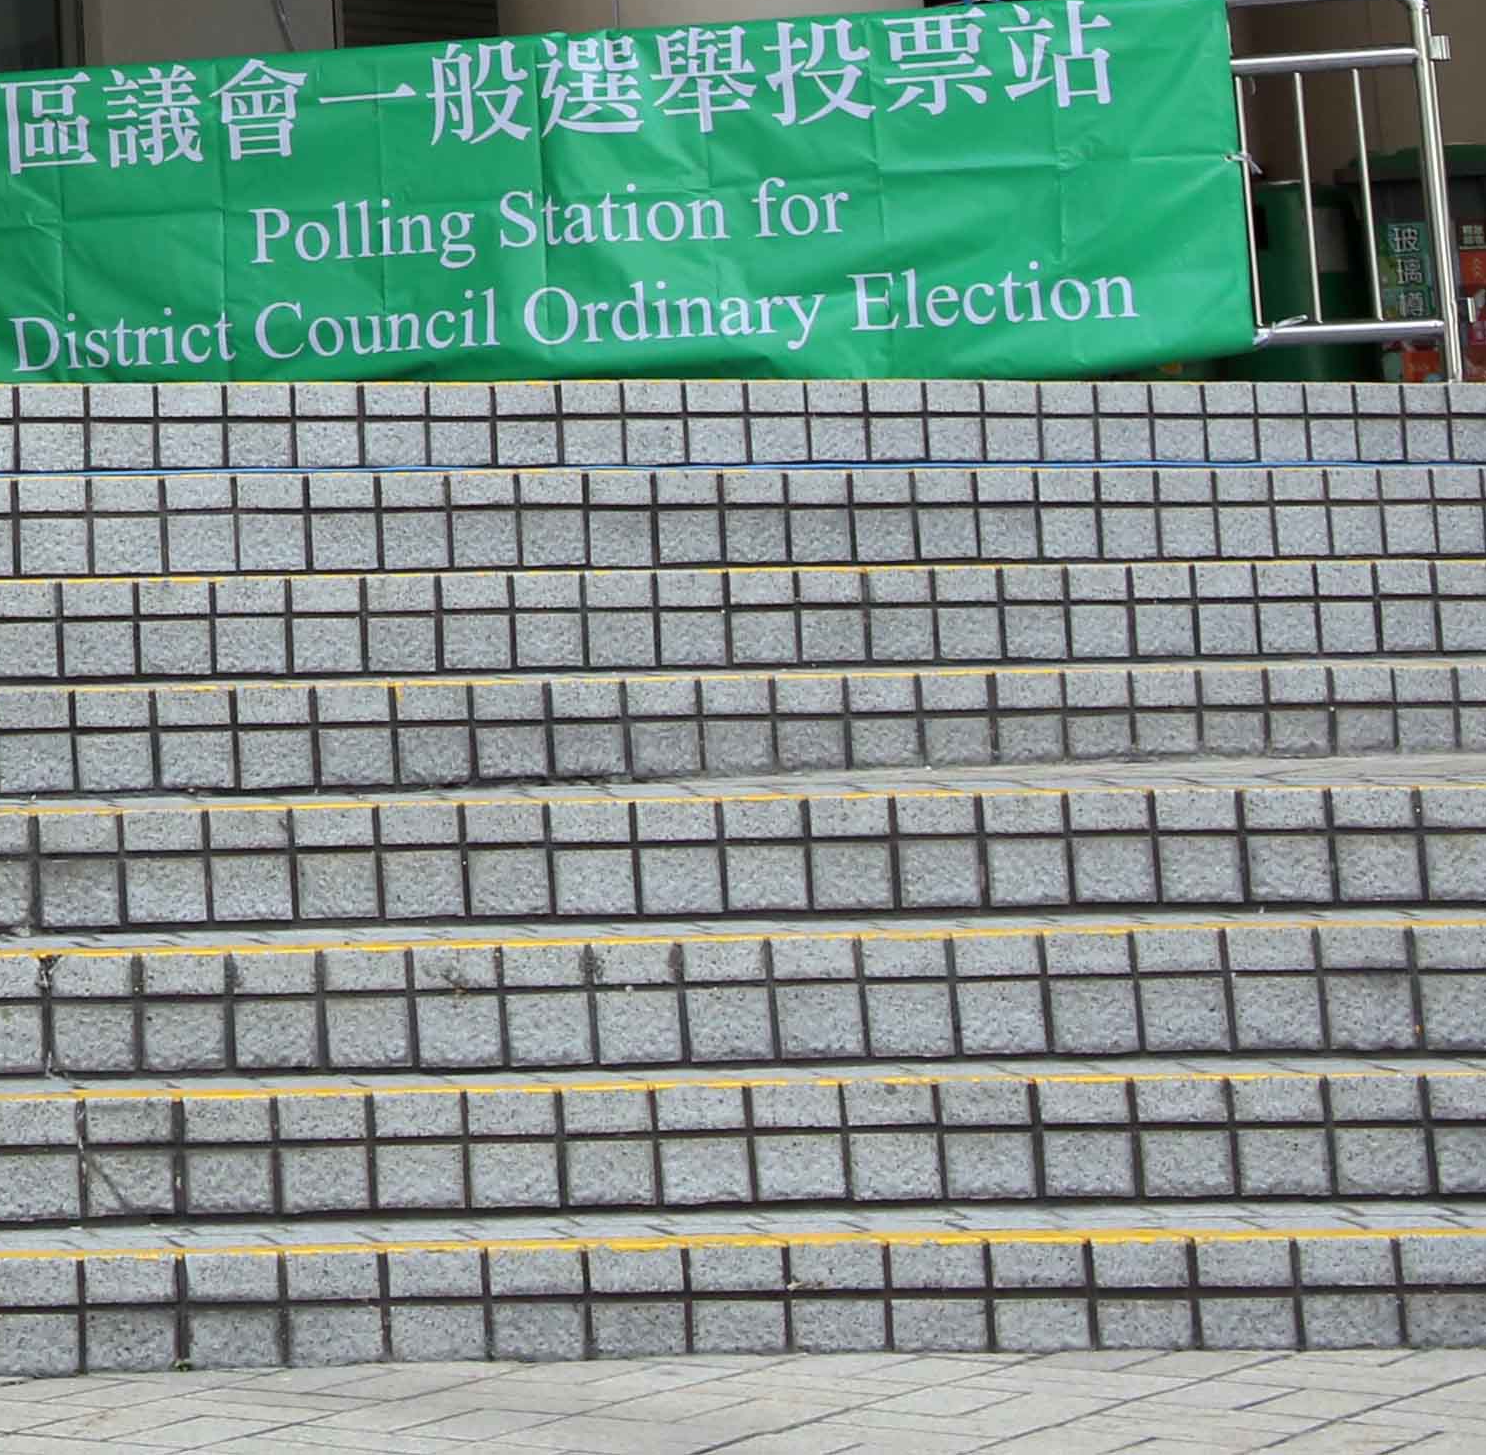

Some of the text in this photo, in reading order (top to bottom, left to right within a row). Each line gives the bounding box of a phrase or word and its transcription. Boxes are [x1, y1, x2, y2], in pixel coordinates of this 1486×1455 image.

[0, 0, 1112, 174] 區議會一般選舉投票站
[250, 177, 849, 269] Polling Station for
[11, 261, 1140, 372] District Council Ordinary Election
